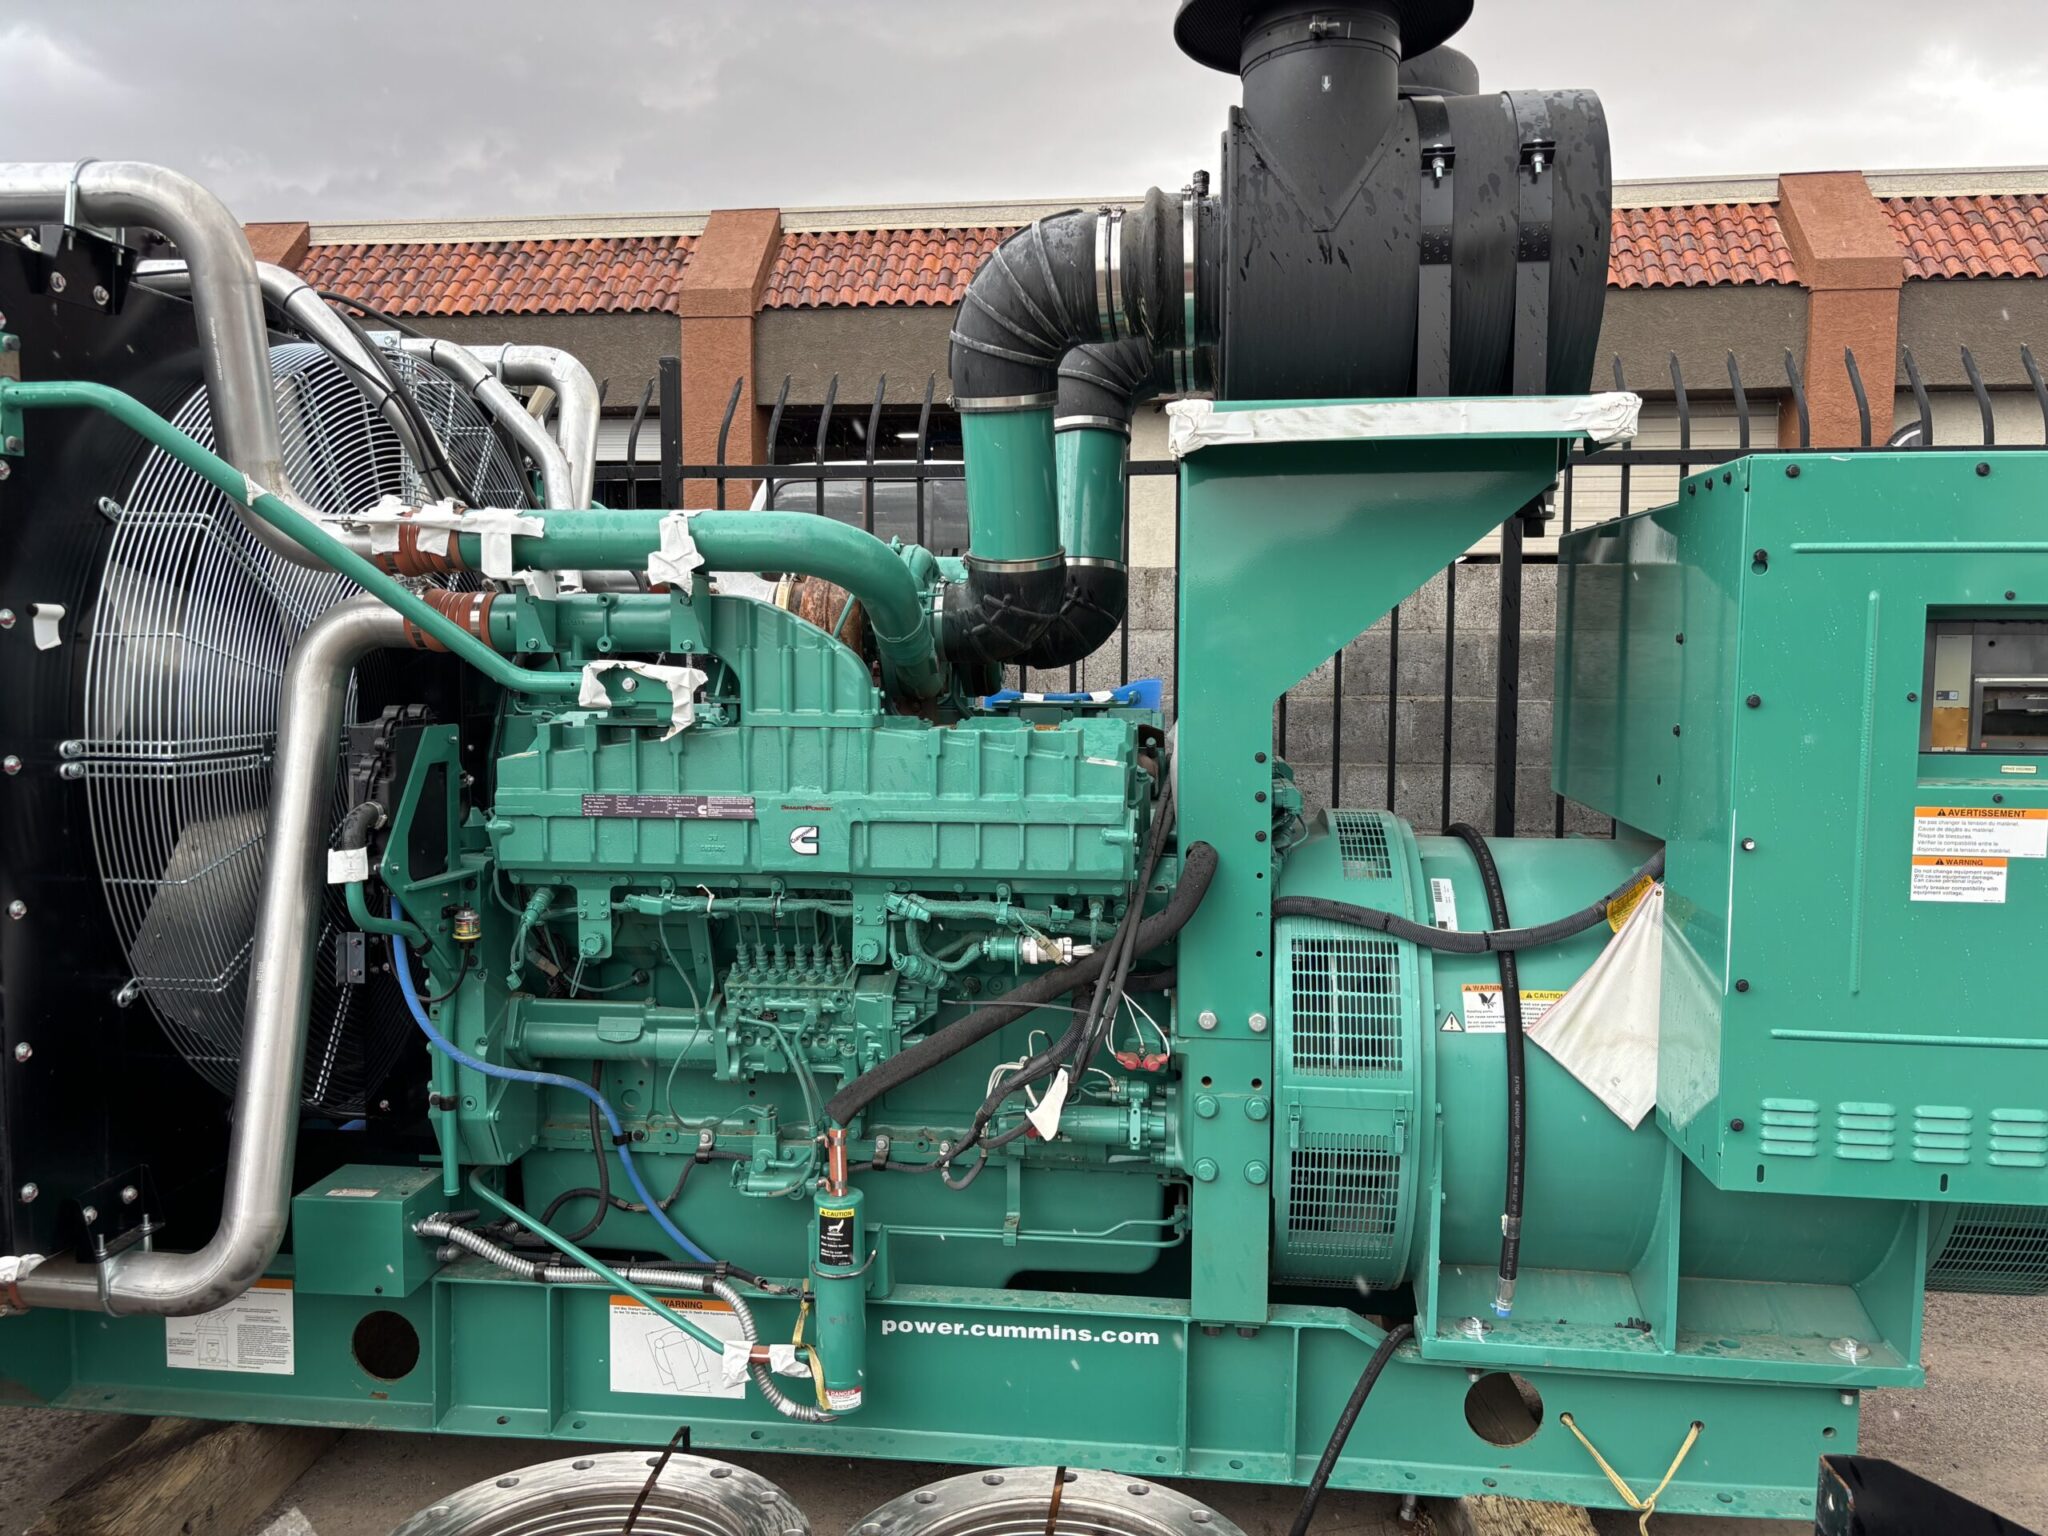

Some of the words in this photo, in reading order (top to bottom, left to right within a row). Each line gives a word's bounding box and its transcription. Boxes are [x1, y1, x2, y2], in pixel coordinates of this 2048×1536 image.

[1948, 809, 2026, 818] AVERTISSEMENT
[662, 1300, 703, 1310] WARNING
[881, 1318, 1160, 1345] power.cummins.com
